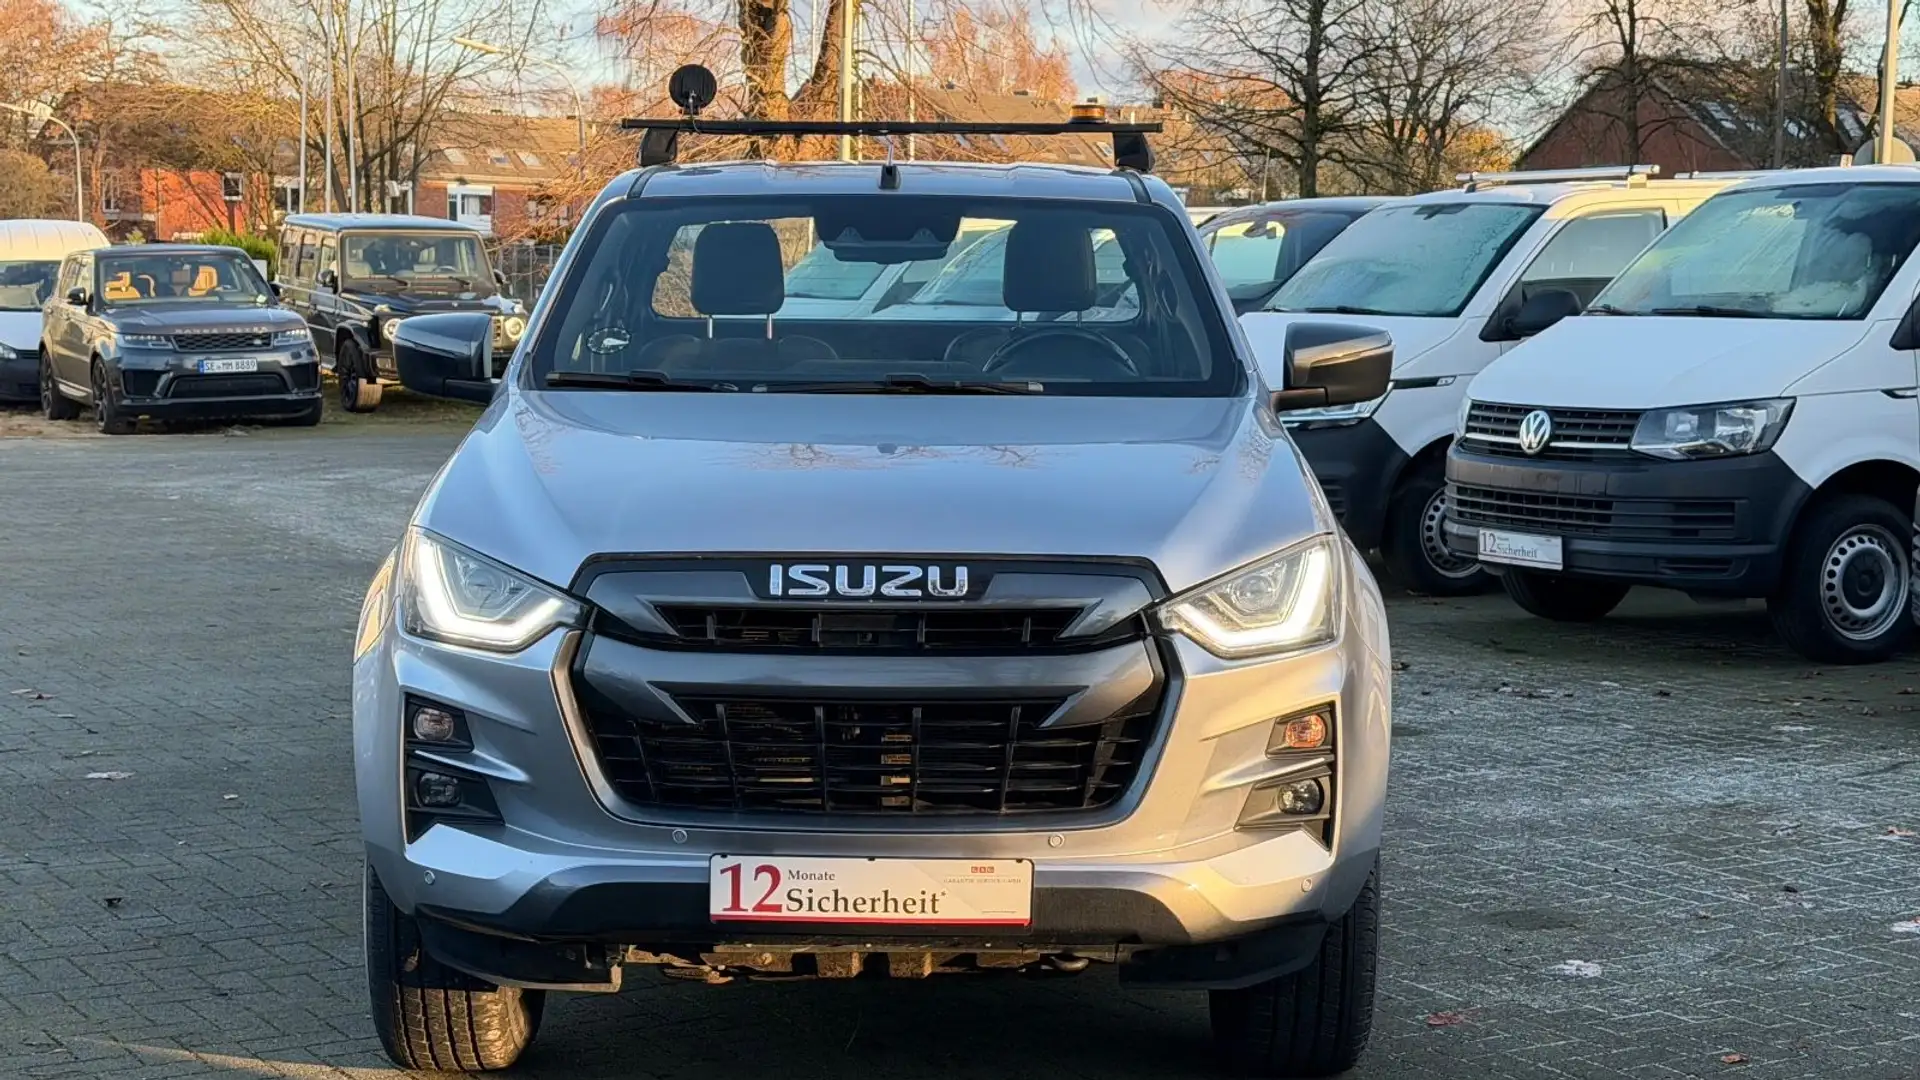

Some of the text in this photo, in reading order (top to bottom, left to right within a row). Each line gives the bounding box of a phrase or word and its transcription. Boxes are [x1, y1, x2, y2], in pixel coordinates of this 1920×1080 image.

[1481, 532, 1497, 553] 12
[769, 564, 968, 597] ISUZU
[719, 863, 835, 913] 12 Monate
